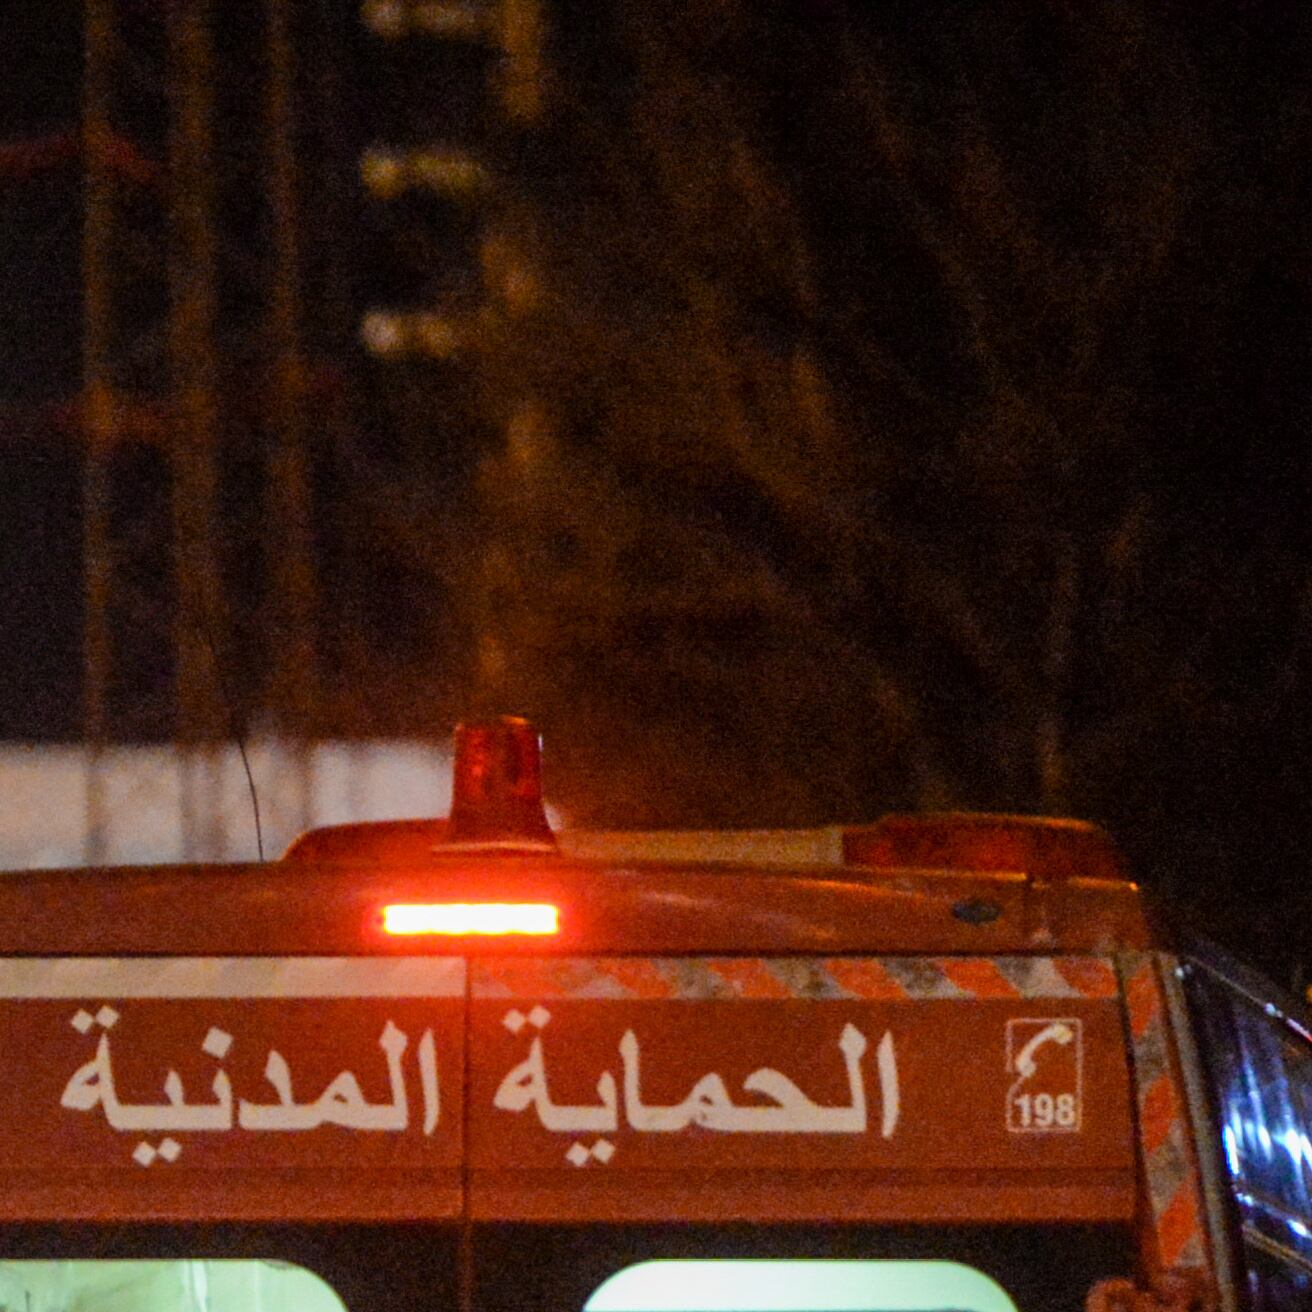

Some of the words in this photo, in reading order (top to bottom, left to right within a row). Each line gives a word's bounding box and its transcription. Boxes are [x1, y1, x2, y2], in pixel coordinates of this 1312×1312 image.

[60, 1004, 441, 1168] المدنية
[493, 1003, 901, 1168] الحماية
[1014, 1092, 1079, 1129] 198
